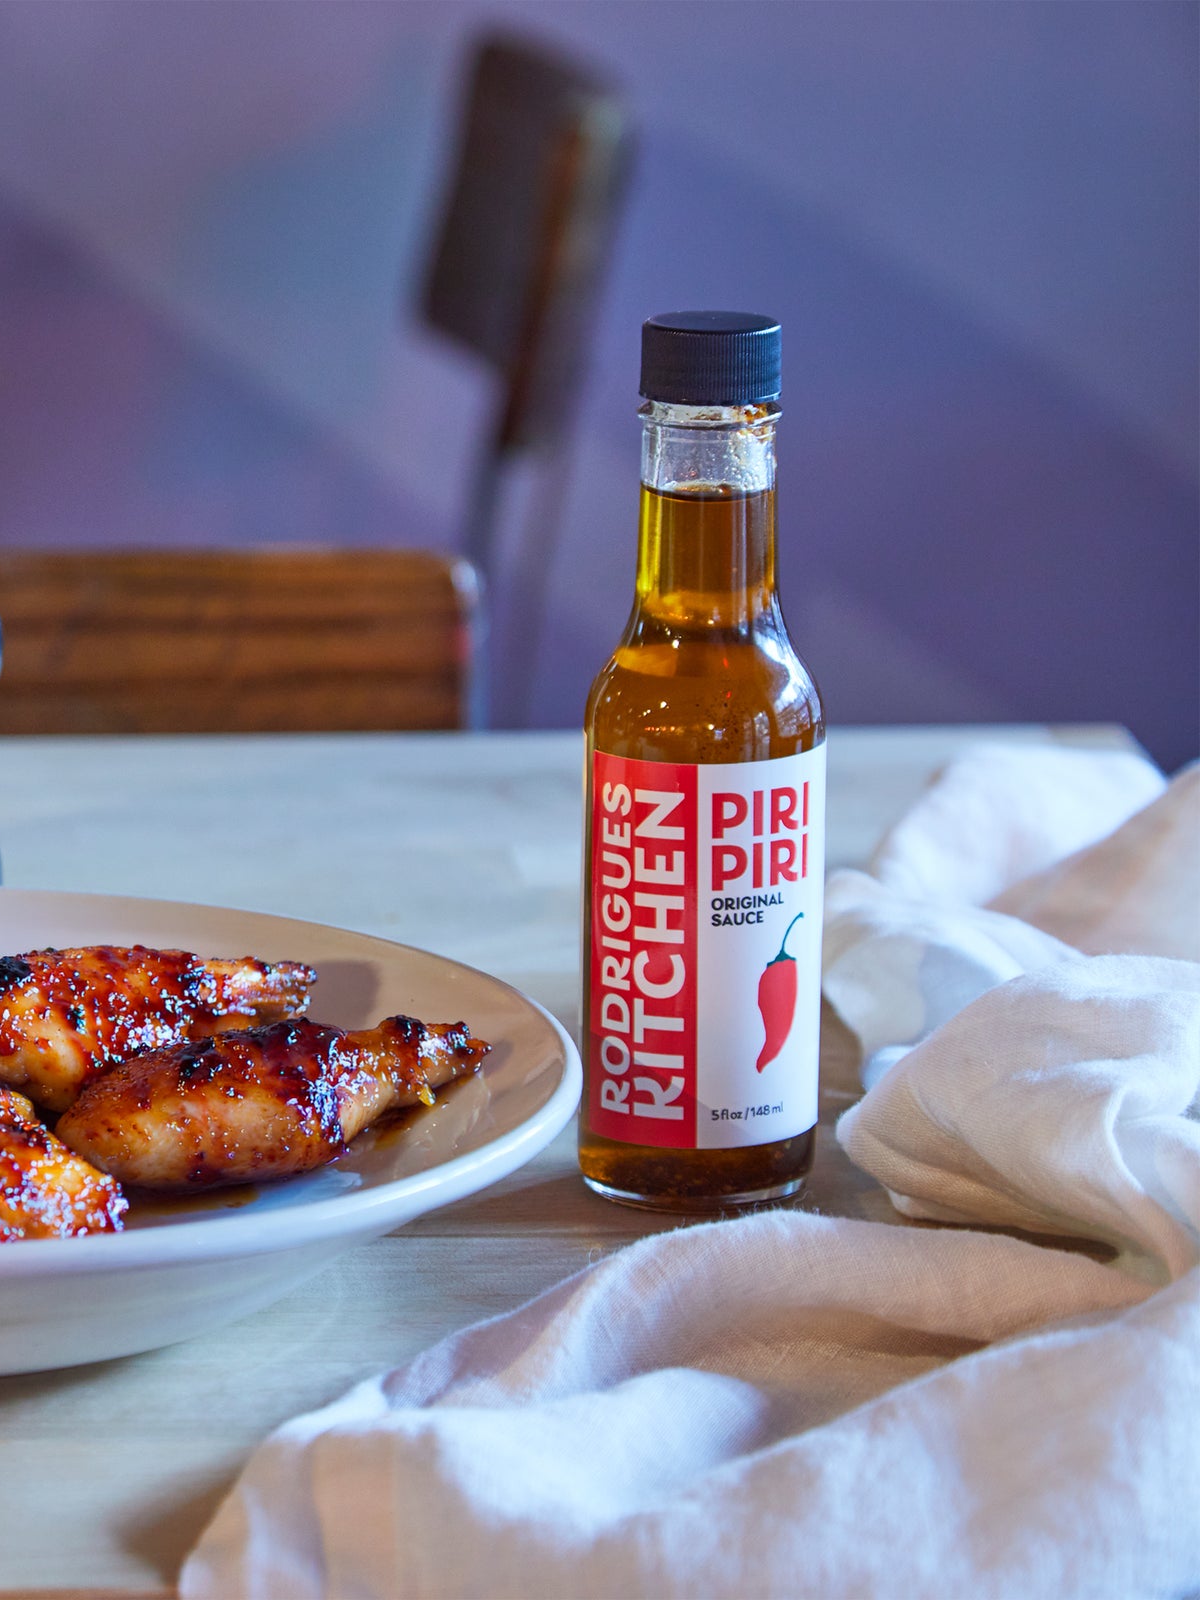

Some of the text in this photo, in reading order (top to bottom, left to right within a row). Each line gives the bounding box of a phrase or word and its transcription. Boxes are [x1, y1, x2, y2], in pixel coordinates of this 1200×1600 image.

[711, 781, 810, 839] PIRI
[711, 833, 809, 891] PIRI
[711, 892, 784, 911] ORIGINAL
[711, 911, 764, 927] SAUCE
[601, 782, 632, 1115] RODRIGUES
[633, 788, 685, 1121] KITCHEN
